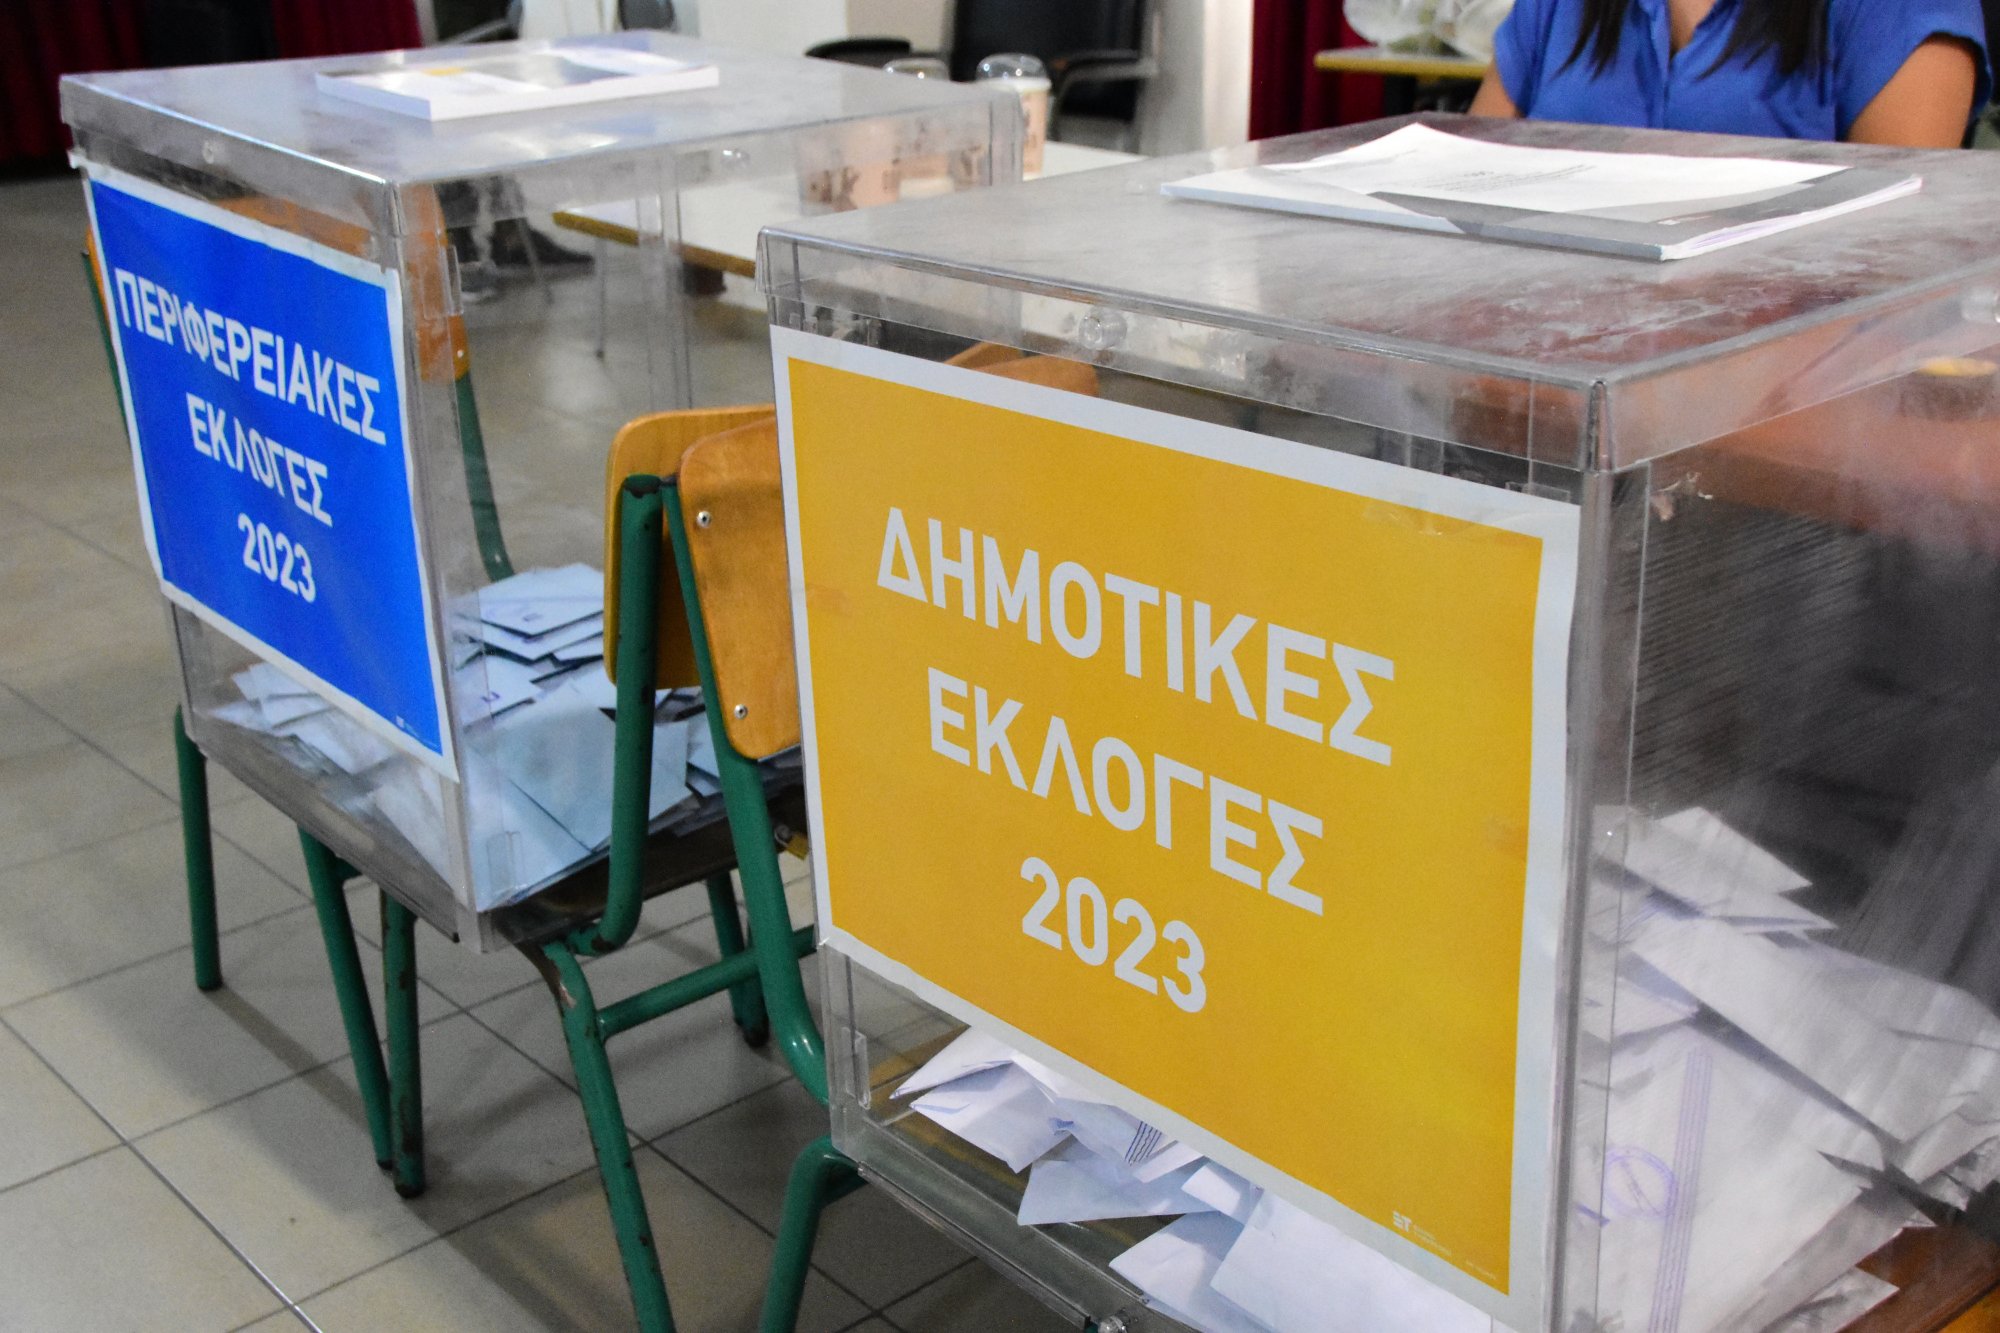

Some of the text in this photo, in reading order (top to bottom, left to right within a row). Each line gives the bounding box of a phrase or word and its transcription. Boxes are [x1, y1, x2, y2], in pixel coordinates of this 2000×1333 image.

[115, 268, 387, 445] ΠΕΡΙΦΕΡΕΙΑΚΕΣ
[186, 393, 332, 526] ΕΚΛΟΓΕΣ
[237, 513, 316, 602] 2023
[876, 506, 1395, 767] ΔΗΜΟΤΙΚΕΣ
[927, 666, 1324, 917] ΕΚΛΟΓΕΣ
[1020, 856, 1207, 1014] 2023
